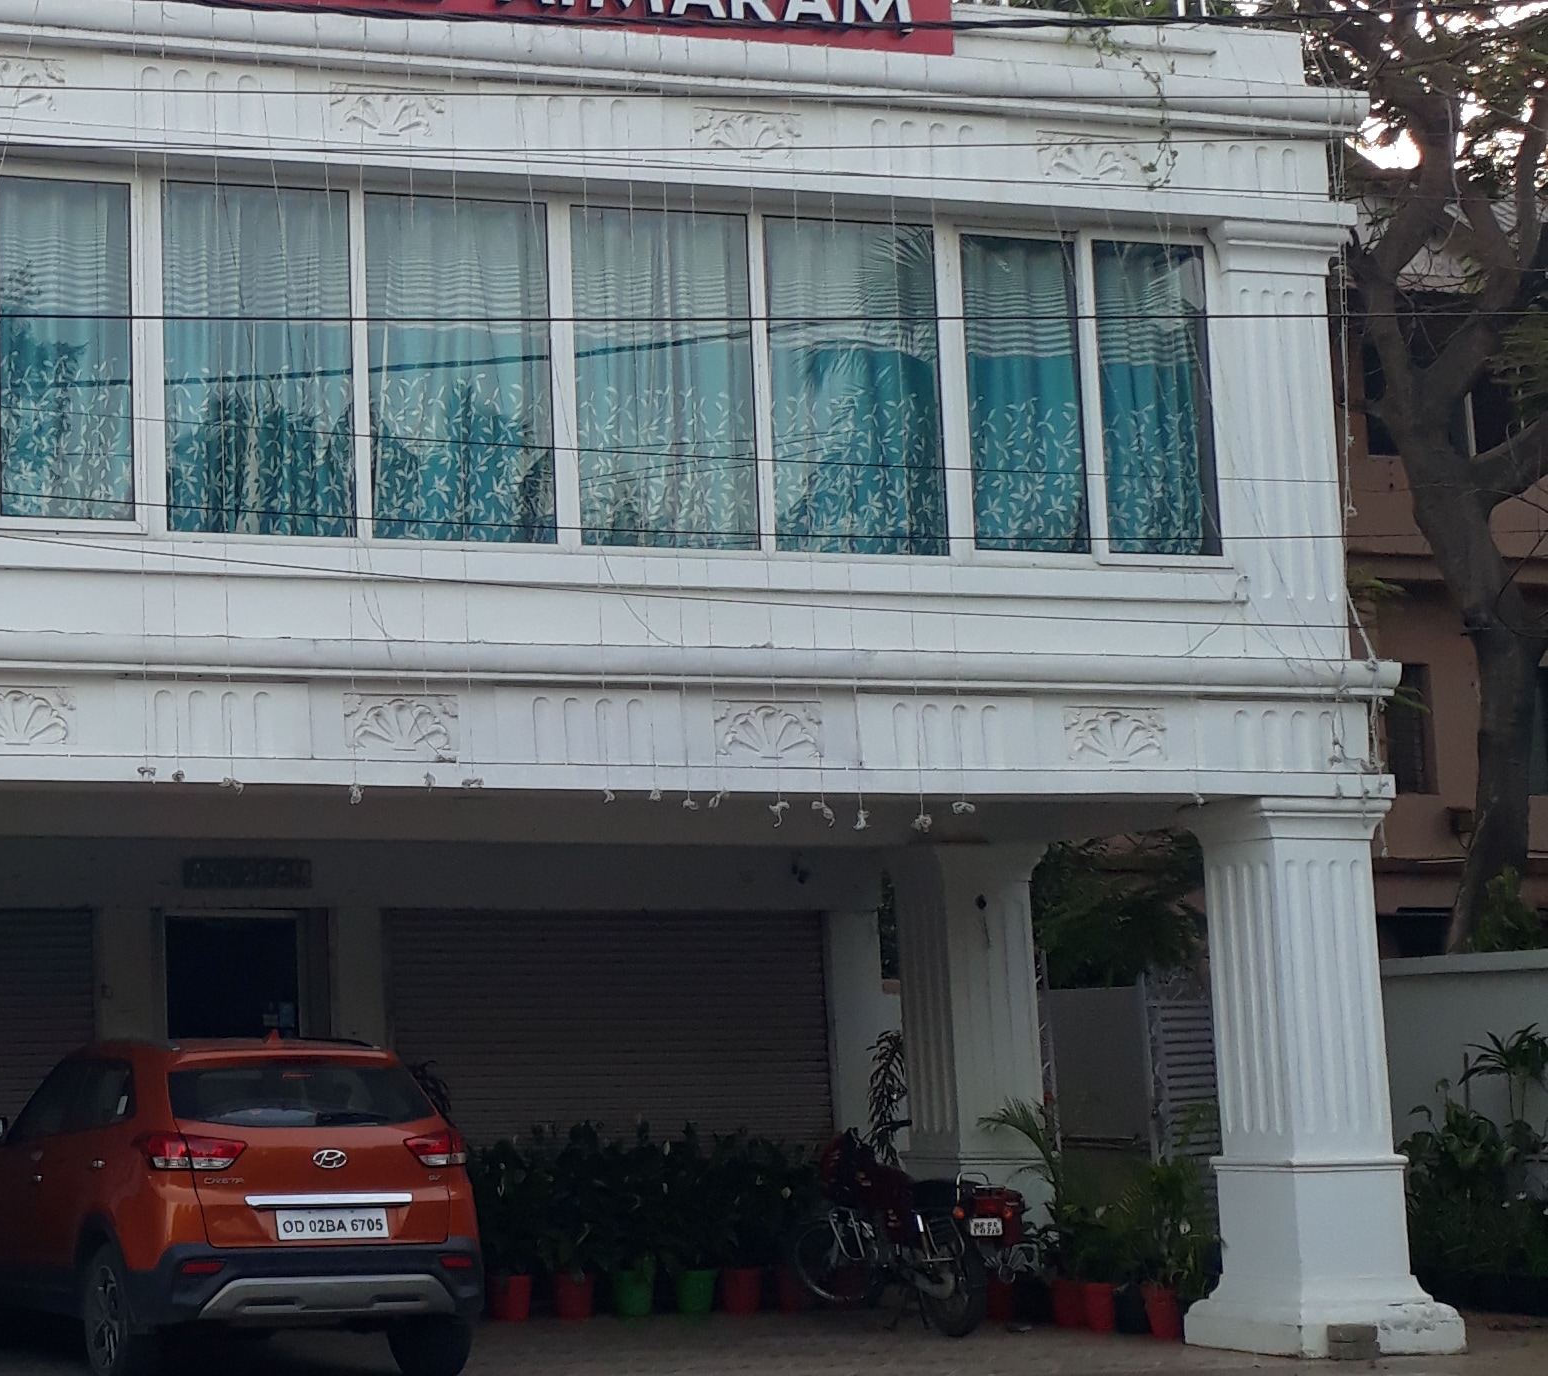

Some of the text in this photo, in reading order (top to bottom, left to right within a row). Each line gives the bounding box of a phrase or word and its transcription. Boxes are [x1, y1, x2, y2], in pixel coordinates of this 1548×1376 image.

[282, 1218, 383, 1233] OD 02BA 6705
